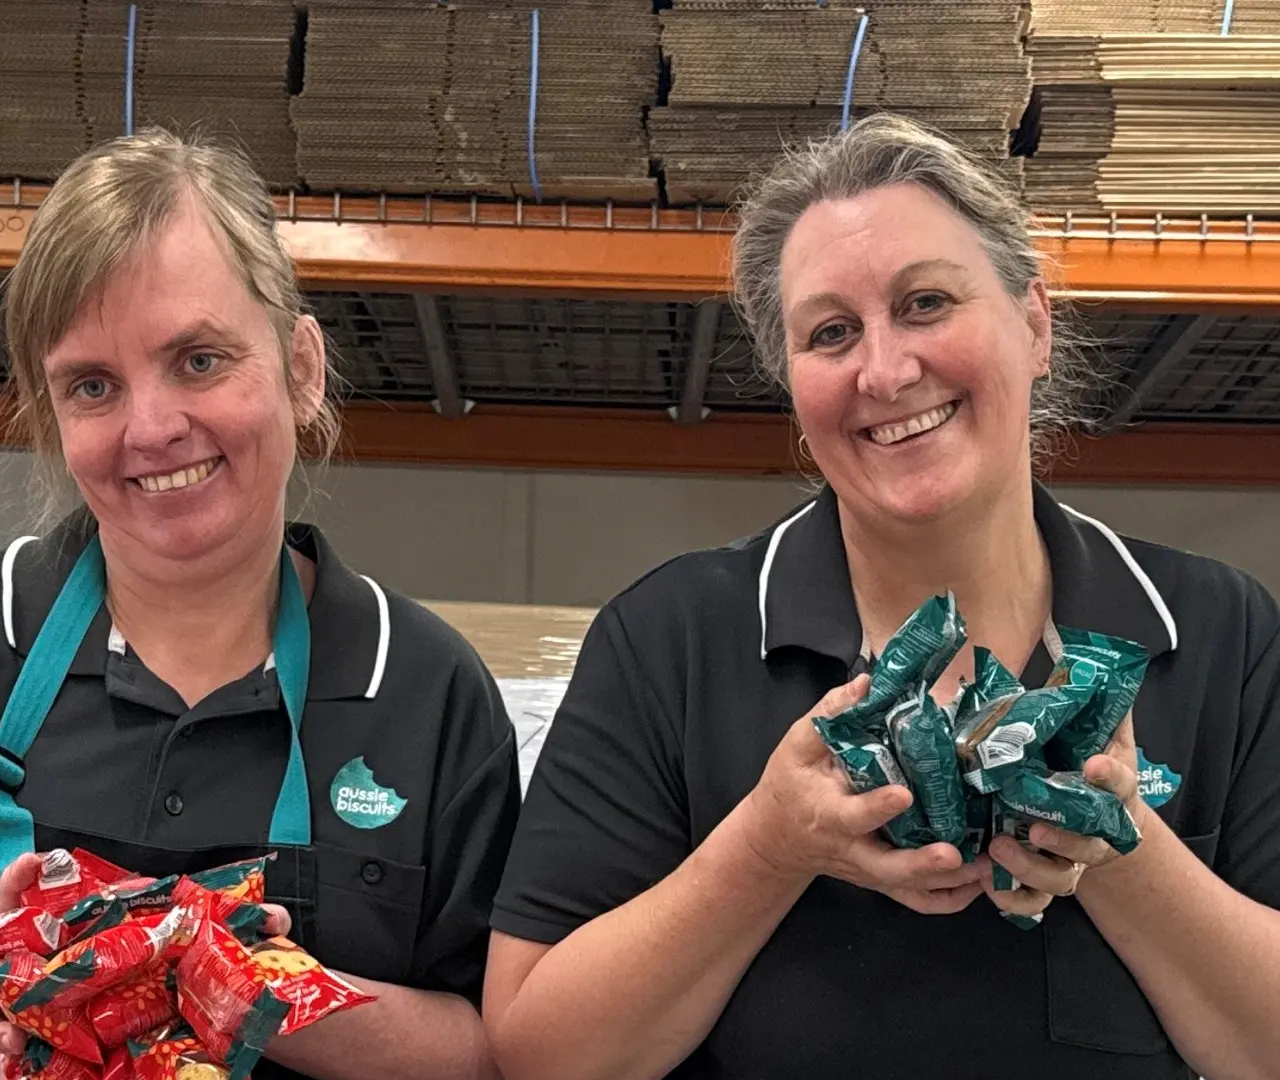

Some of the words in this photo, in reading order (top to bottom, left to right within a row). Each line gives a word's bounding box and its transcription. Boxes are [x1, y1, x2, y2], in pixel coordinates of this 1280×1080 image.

[1136, 766, 1163, 780] sie
[338, 786, 389, 803] aussie
[1025, 804, 1067, 824] biscuits
